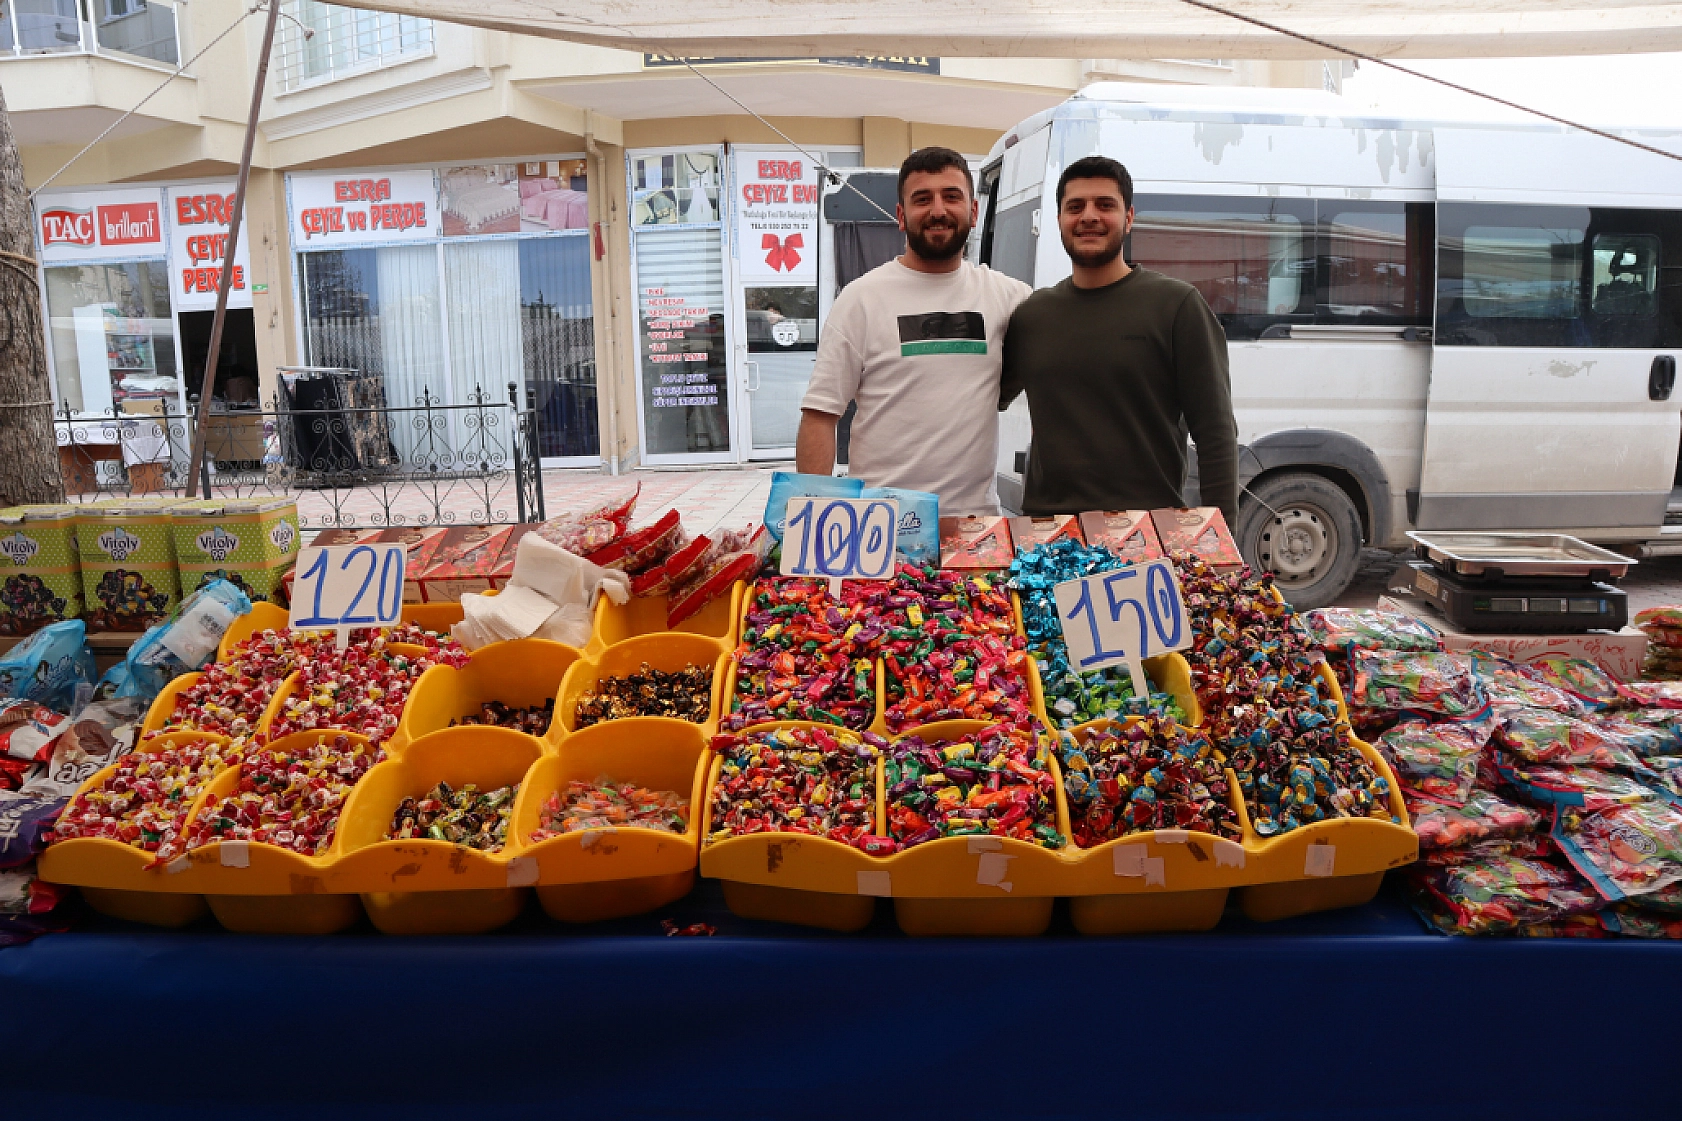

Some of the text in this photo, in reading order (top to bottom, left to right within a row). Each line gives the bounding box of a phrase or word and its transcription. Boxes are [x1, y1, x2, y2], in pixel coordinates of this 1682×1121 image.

[758, 160, 801, 181] ESRA
[335, 178, 390, 202] ESRA
[43, 211, 155, 244] TAÇ brillant
[347, 211, 366, 231] ve
[370, 201, 427, 232] PERDE
[182, 265, 244, 294] PERE
[788, 500, 896, 576] 100
[295, 545, 402, 627] 120
[1066, 563, 1182, 666] 150
